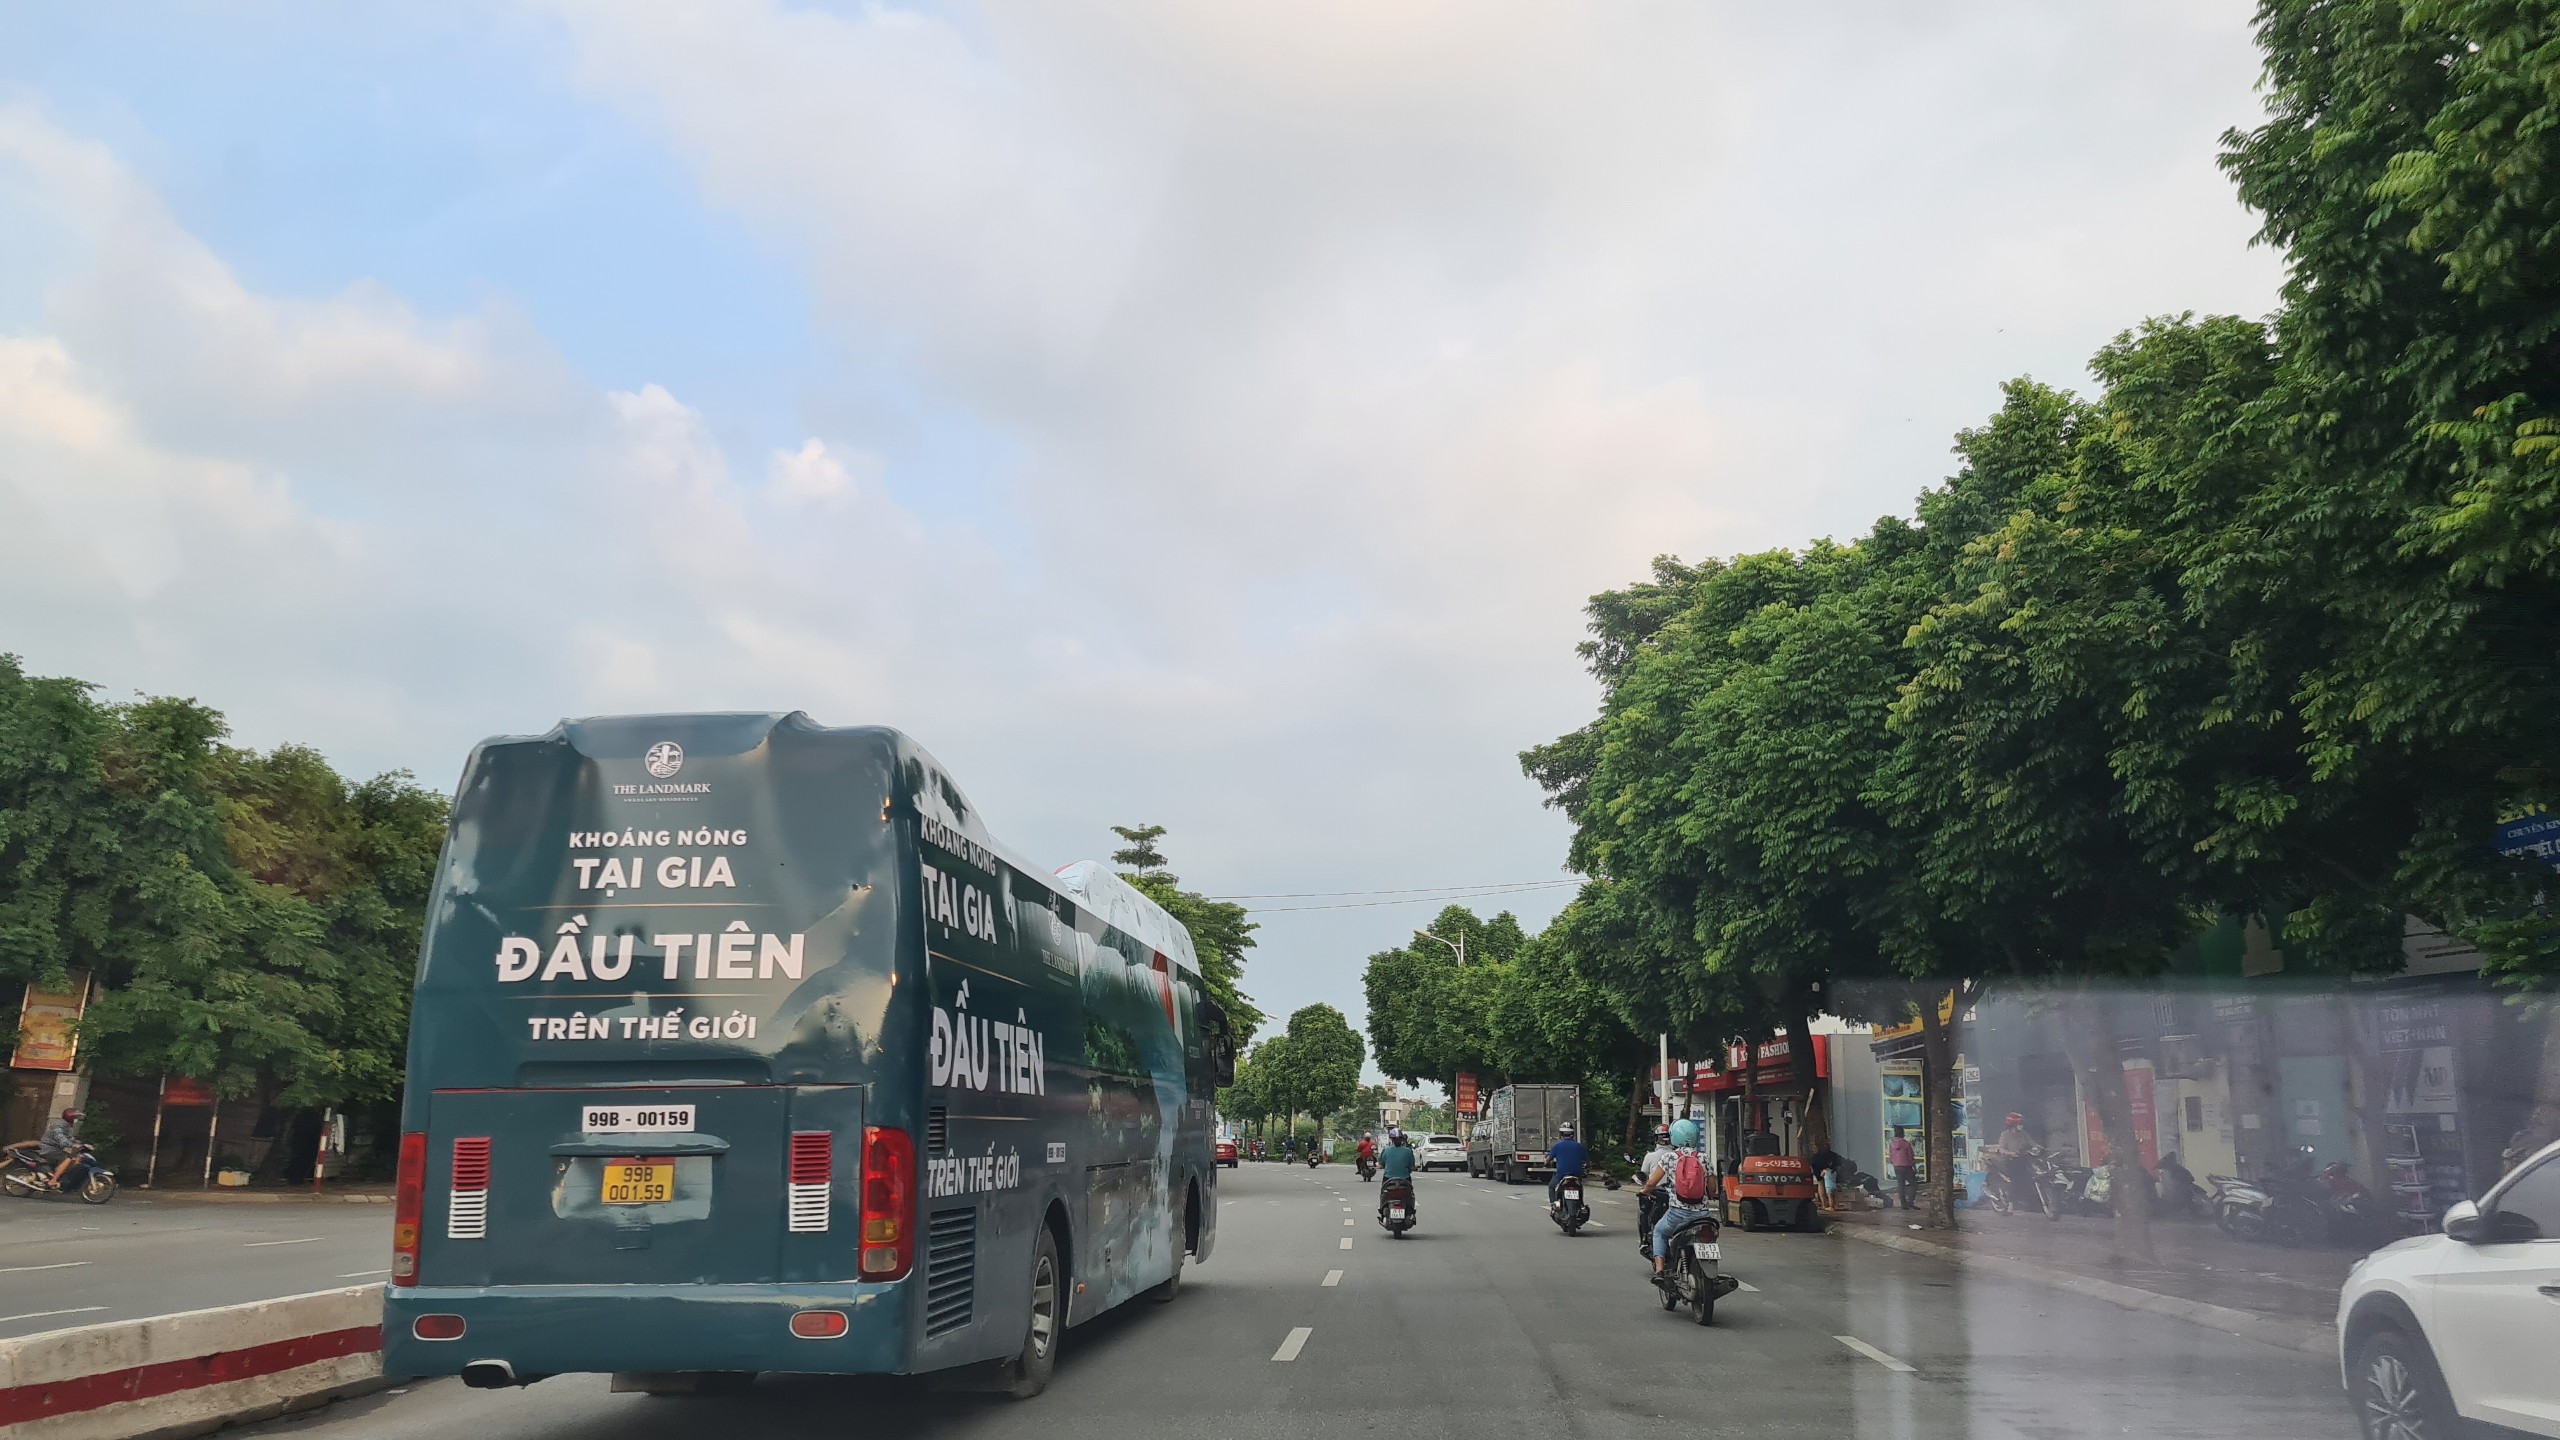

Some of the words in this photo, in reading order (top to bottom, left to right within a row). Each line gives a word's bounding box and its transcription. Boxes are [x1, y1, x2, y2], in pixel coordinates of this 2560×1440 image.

[613, 785, 637, 795] THE
[639, 783, 711, 794] LANDMARK
[569, 826, 671, 849] KHOÁNG
[677, 825, 748, 847] NÓNG
[573, 858, 642, 897] TẠI
[657, 856, 736, 889] GIA
[922, 864, 960, 940] TẠI
[963, 884, 997, 945] GIA
[496, 914, 634, 983] ĐẦU
[654, 920, 805, 981] TIÊN
[528, 1011, 610, 1041] TRÊN
[620, 1007, 684, 1040] THẾ
[688, 1010, 757, 1040] GIỚI
[930, 978, 990, 1092] ĐẦU
[994, 1007, 1045, 1097] TIÊN
[588, 1110, 619, 1127] 99B
[637, 1110, 689, 1126] 00159
[623, 1166, 653, 1182] 99B
[928, 1148, 965, 1199] TRÊN
[968, 1141, 995, 1191] THẾ
[995, 1145, 1020, 1190] GIỚI
[1758, 1175, 1802, 1183] TOYOTA
[608, 1184, 665, 1202] 001.59
